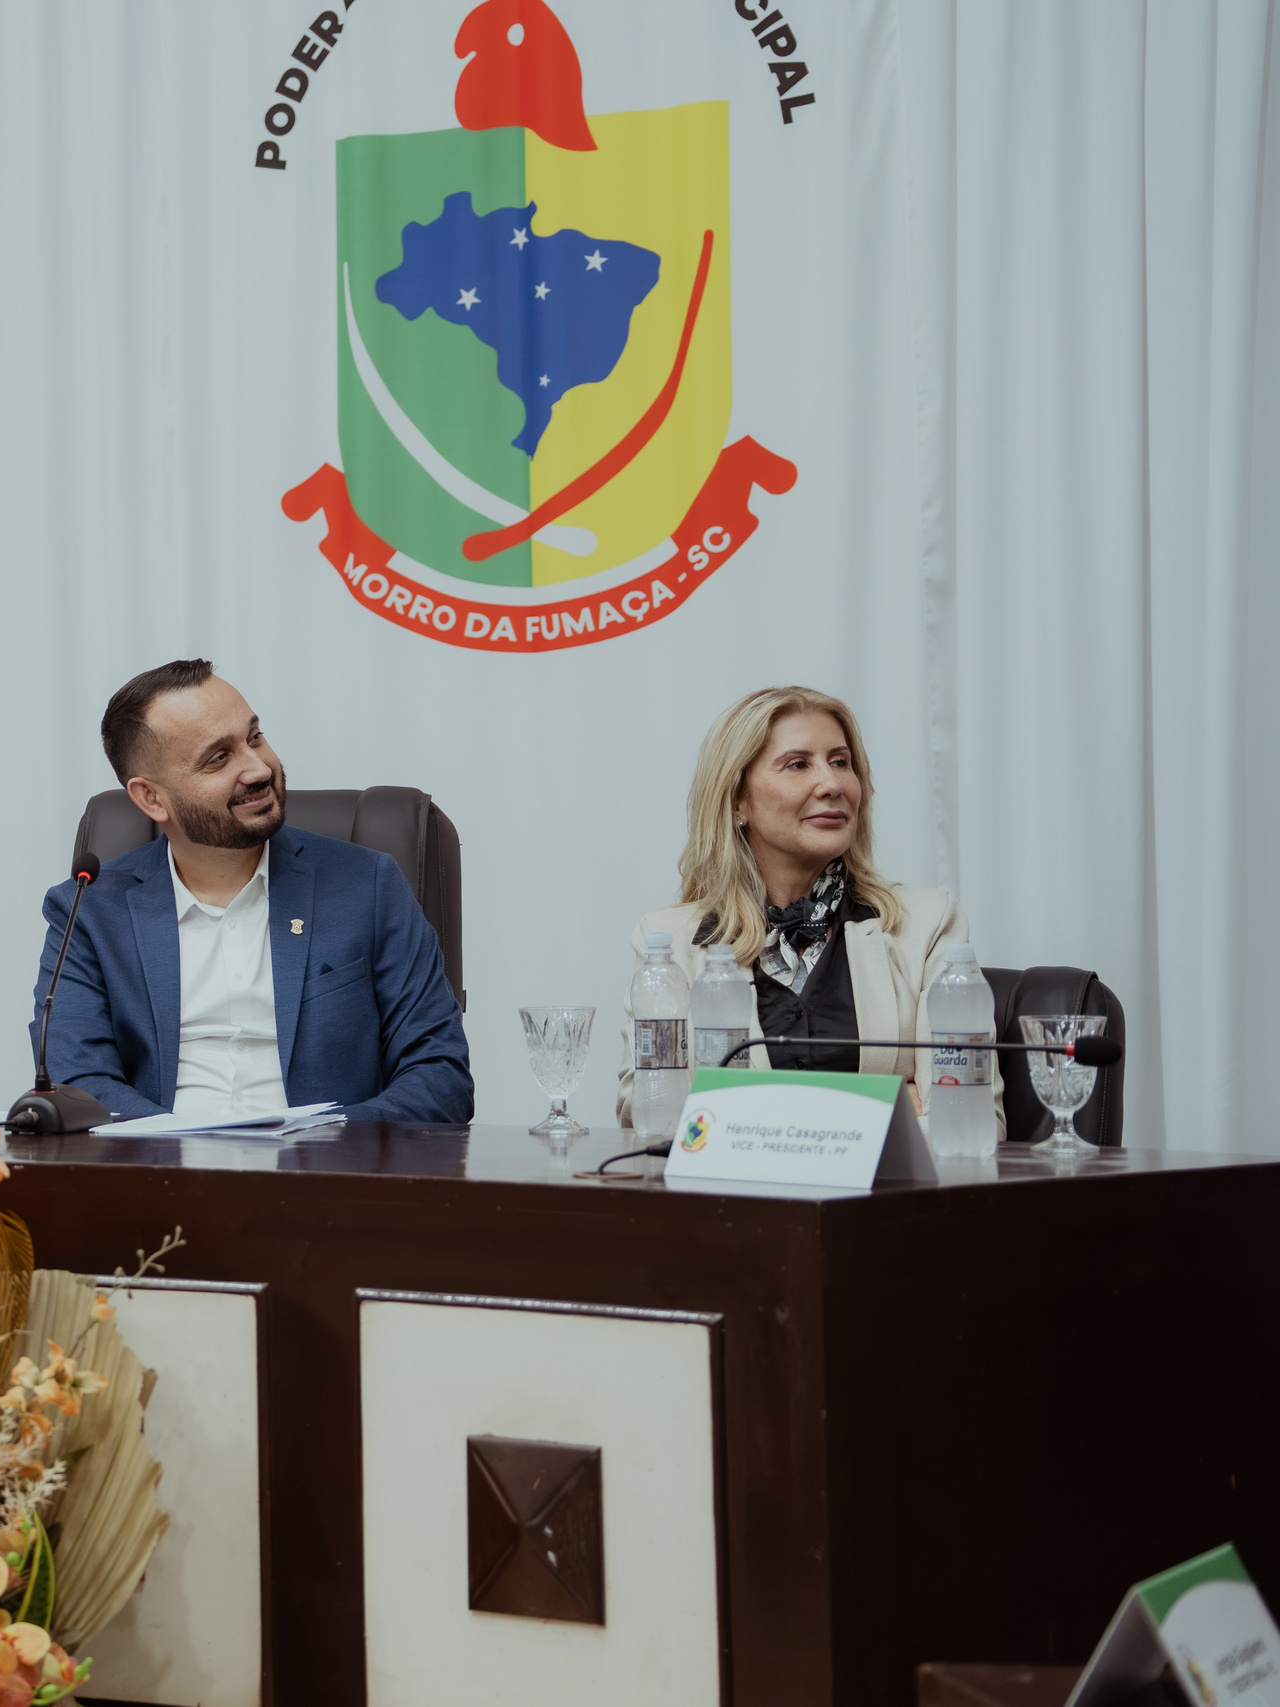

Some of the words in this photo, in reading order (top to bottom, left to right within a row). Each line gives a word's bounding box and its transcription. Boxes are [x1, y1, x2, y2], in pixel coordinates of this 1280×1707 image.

[254, 10, 344, 170] PODER
[343, 552, 457, 631] MORRO
[463, 612, 517, 642] DA
[526, 580, 676, 642] FUMAÇA
[677, 572, 688, 583] -
[686, 526, 731, 571] SC
[934, 1053, 968, 1066] Guarda
[726, 1122, 782, 1138] Henrique
[786, 1126, 863, 1142] Casagrande
[731, 1140, 753, 1150] VICE
[762, 1143, 826, 1155] PRESIDENTE
